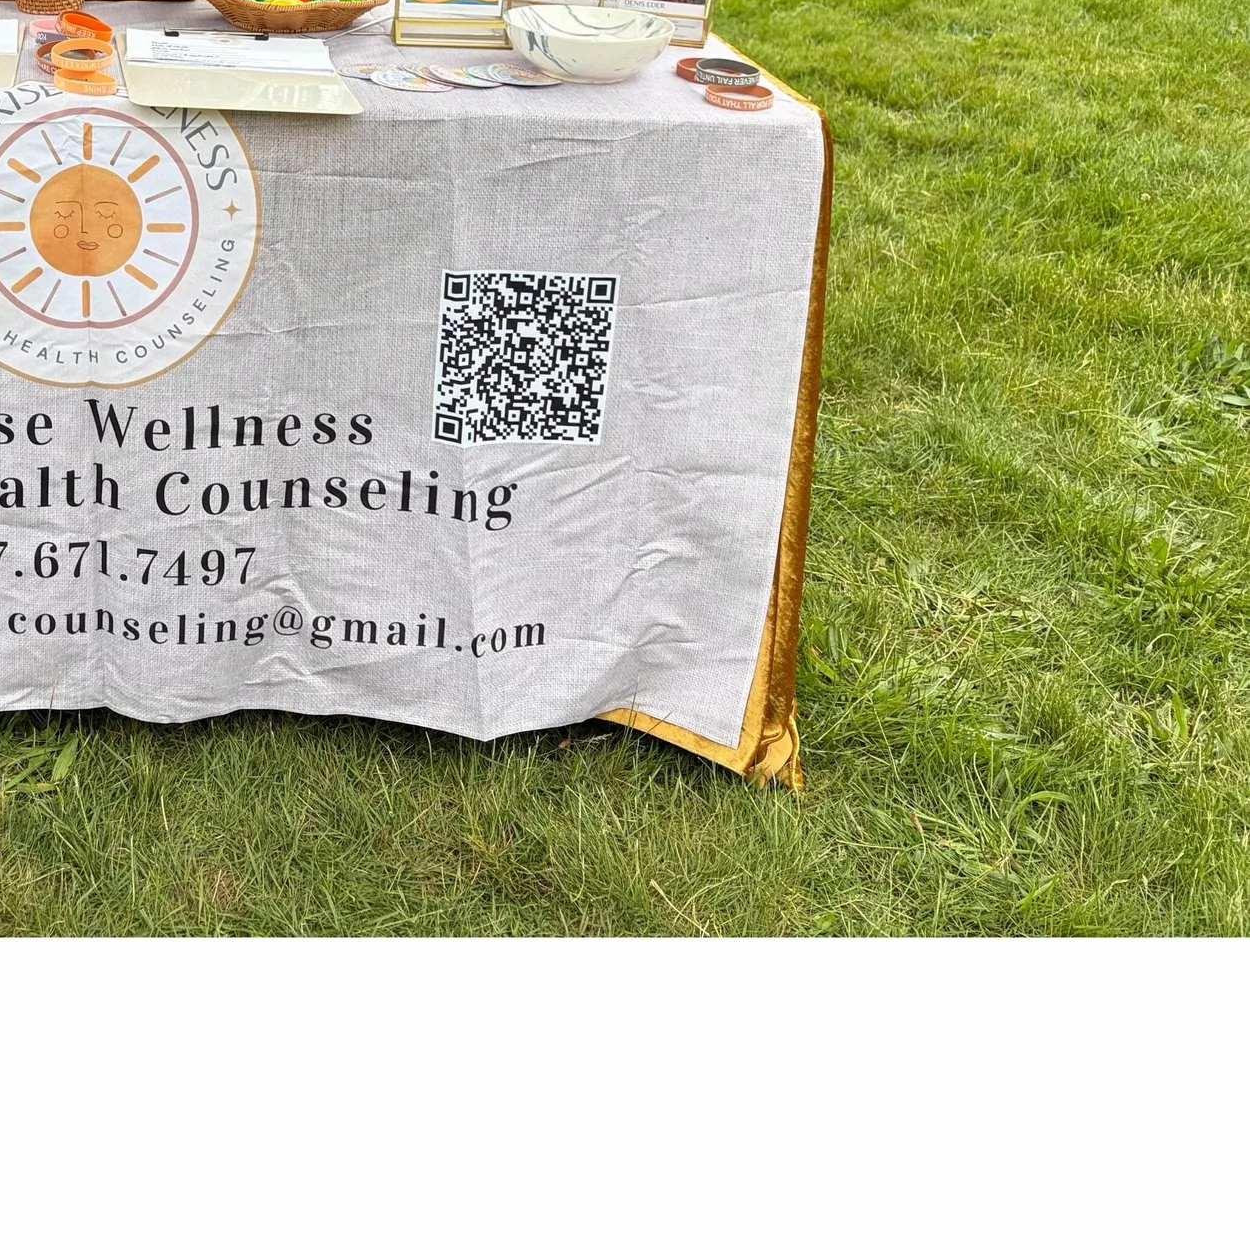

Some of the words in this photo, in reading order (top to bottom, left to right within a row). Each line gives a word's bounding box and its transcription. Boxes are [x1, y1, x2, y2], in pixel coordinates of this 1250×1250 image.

[625, 0, 645, 8] DENIS
[77, 30, 96, 38] KEEP
[76, 61, 96, 69] YOUR
[700, 72, 715, 82] UNTIL
[717, 76, 733, 85] FAIL
[734, 76, 755, 86] NEVER
[722, 98, 740, 109] THAT
[744, 101, 755, 109] ALL
[757, 100, 768, 109] FOR
[150, 106, 238, 190] NESS
[4, 331, 100, 364] HEALTH
[116, 239, 236, 364] COUNSELING
[84, 399, 374, 451] Wellness
[155, 471, 518, 531] Counseling
